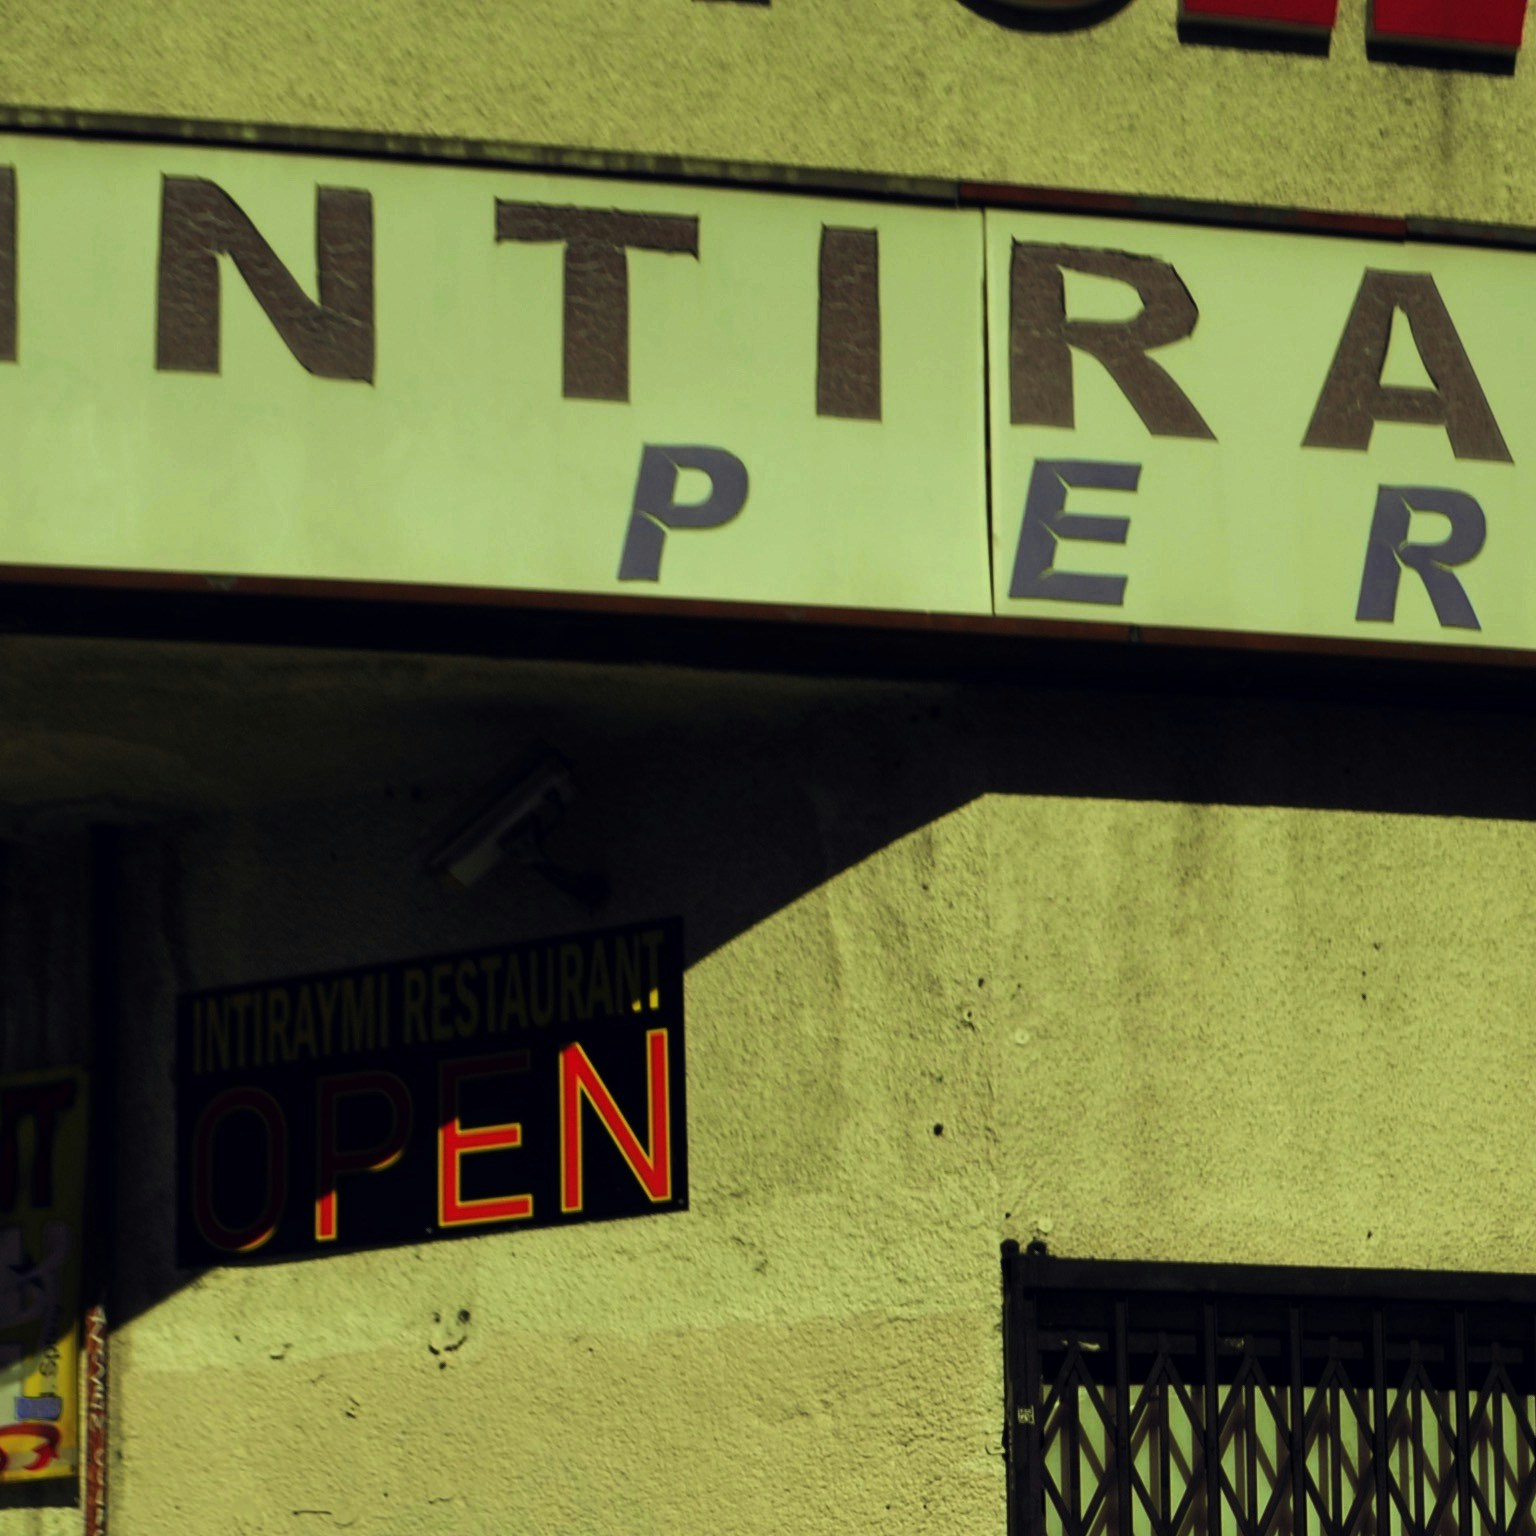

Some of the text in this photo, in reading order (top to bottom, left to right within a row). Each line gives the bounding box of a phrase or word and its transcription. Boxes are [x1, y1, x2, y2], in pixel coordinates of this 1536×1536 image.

[191, 928, 665, 1075] INTIRAYMI RESTAURANT
[191, 1027, 672, 1254] OPEN
